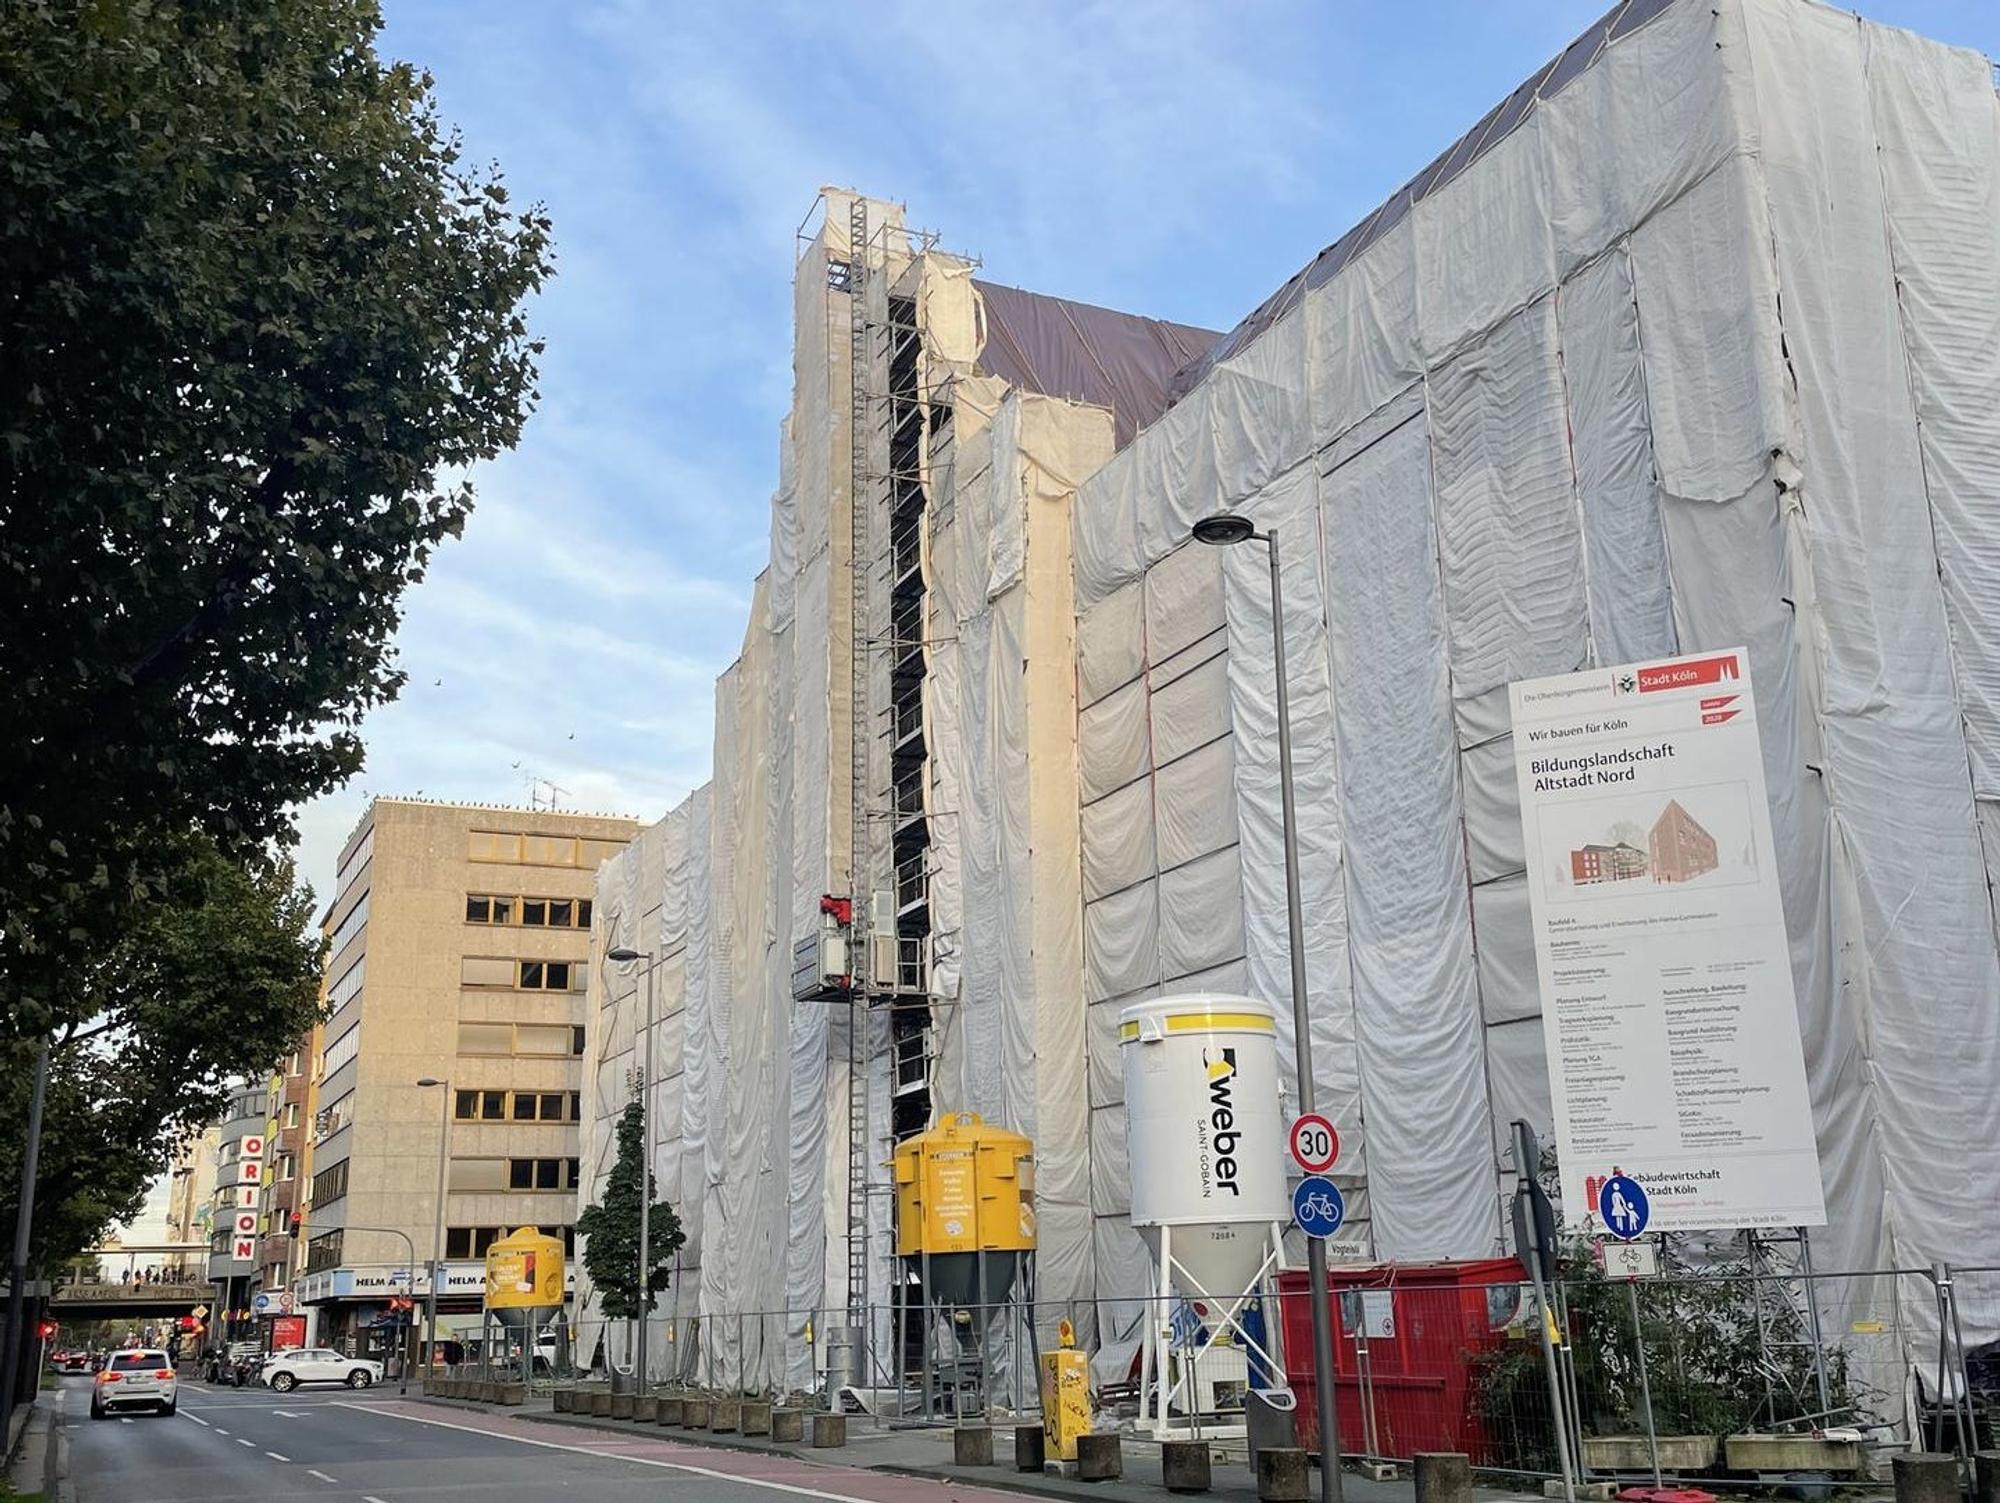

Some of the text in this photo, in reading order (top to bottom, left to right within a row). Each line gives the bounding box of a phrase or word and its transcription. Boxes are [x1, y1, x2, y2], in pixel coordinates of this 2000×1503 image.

[1640, 669, 1698, 687] Stadt Köln
[1529, 719, 1628, 742] Wir bauen für Köln
[1531, 743, 1675, 774] Bildungslandschaft
[1534, 767, 1635, 792] Altstadt Nord
[1209, 1076, 1242, 1197] weber
[1300, 1130, 1329, 1157] 30
[238, 1138, 262, 1257] ORION
[1646, 1184, 1697, 1196] Stadt Köln
[356, 1277, 387, 1287] HELM
[448, 1276, 477, 1285] HELM
